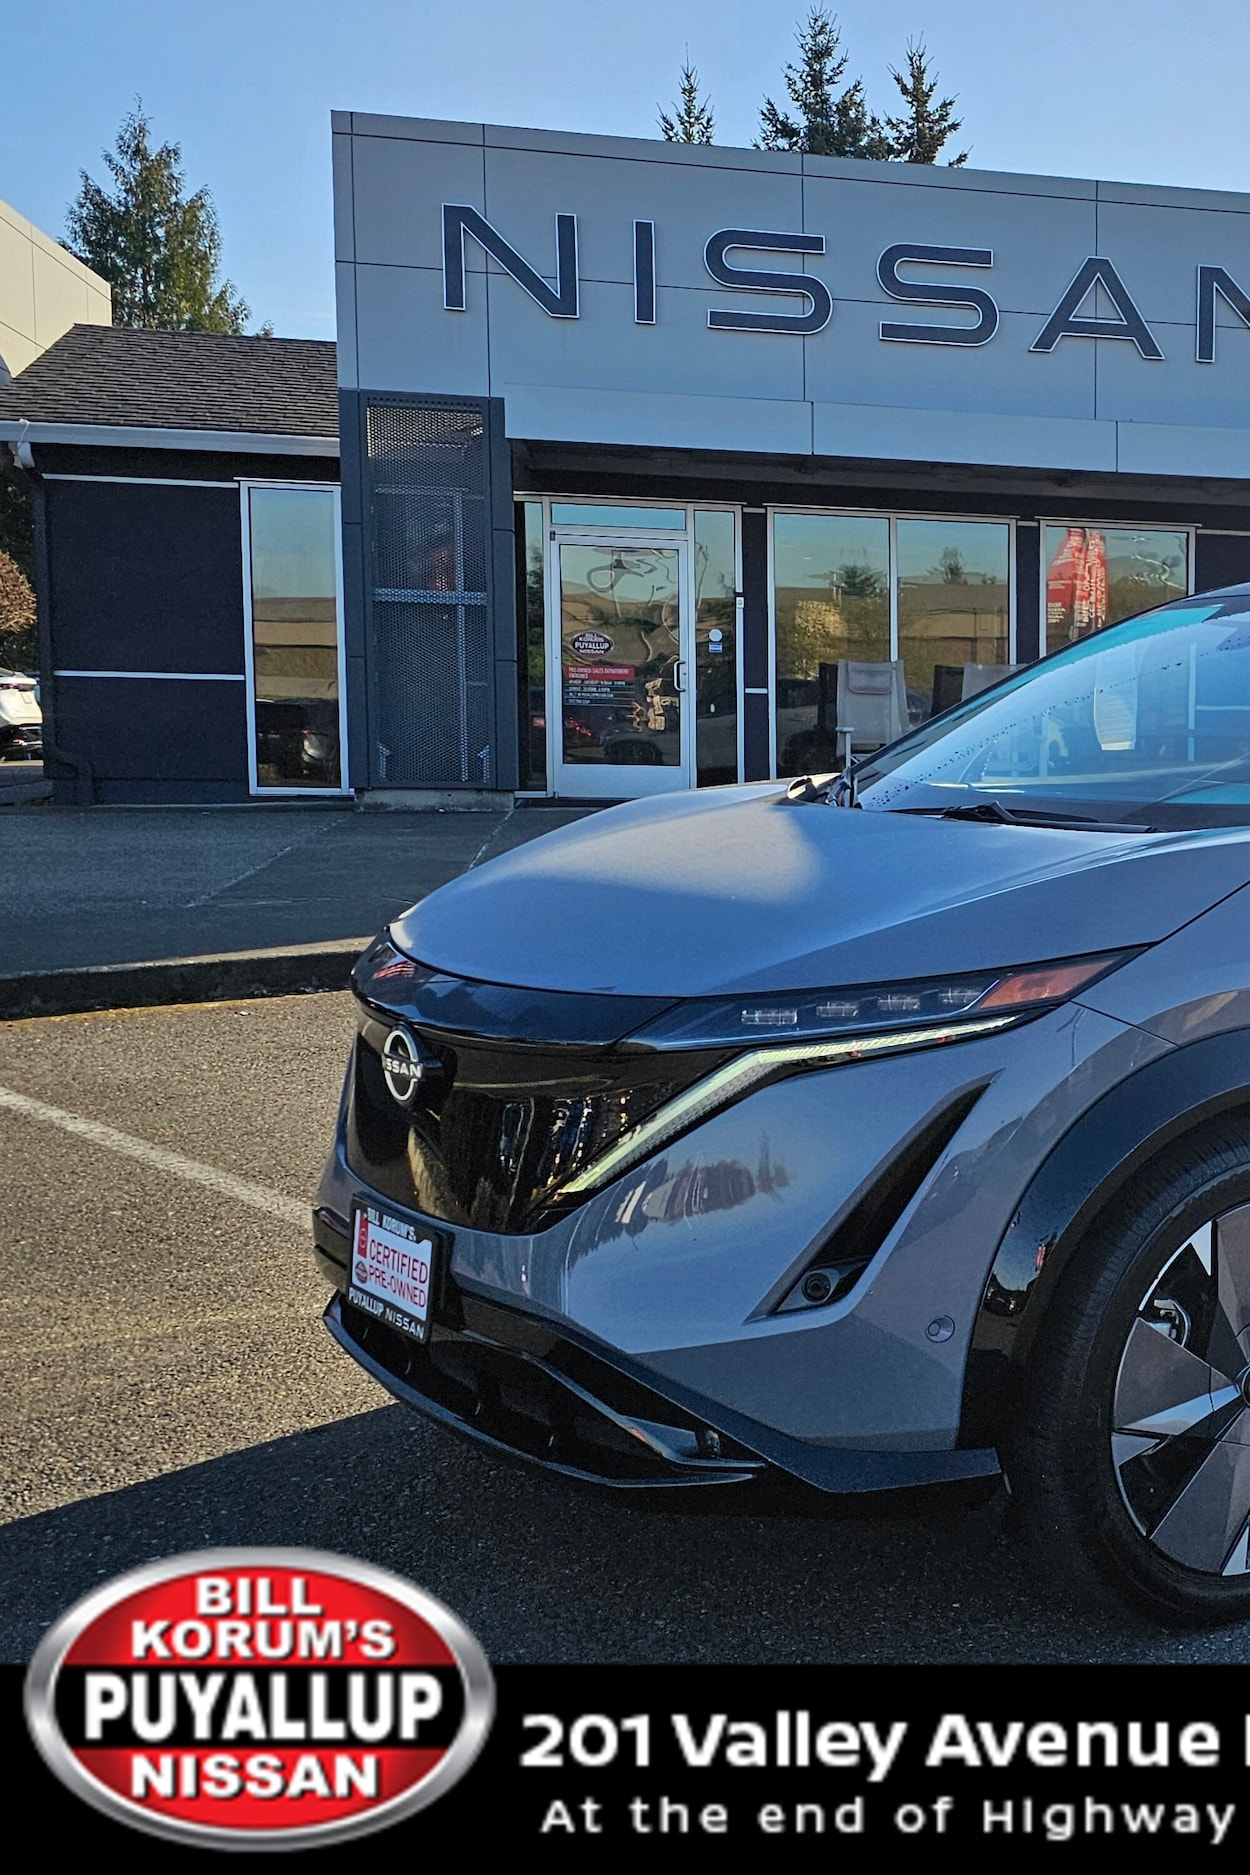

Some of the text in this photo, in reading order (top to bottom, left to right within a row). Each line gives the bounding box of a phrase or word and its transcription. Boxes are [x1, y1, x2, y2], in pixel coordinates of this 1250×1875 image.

[574, 641, 610, 649] PUYALLUP
[367, 1207, 380, 1225] BILL
[368, 1239, 429, 1284] CERTIFIED
[368, 1265, 427, 1308] PRE-OWNED
[348, 1287, 425, 1340] PUYALLUP NISSAN
